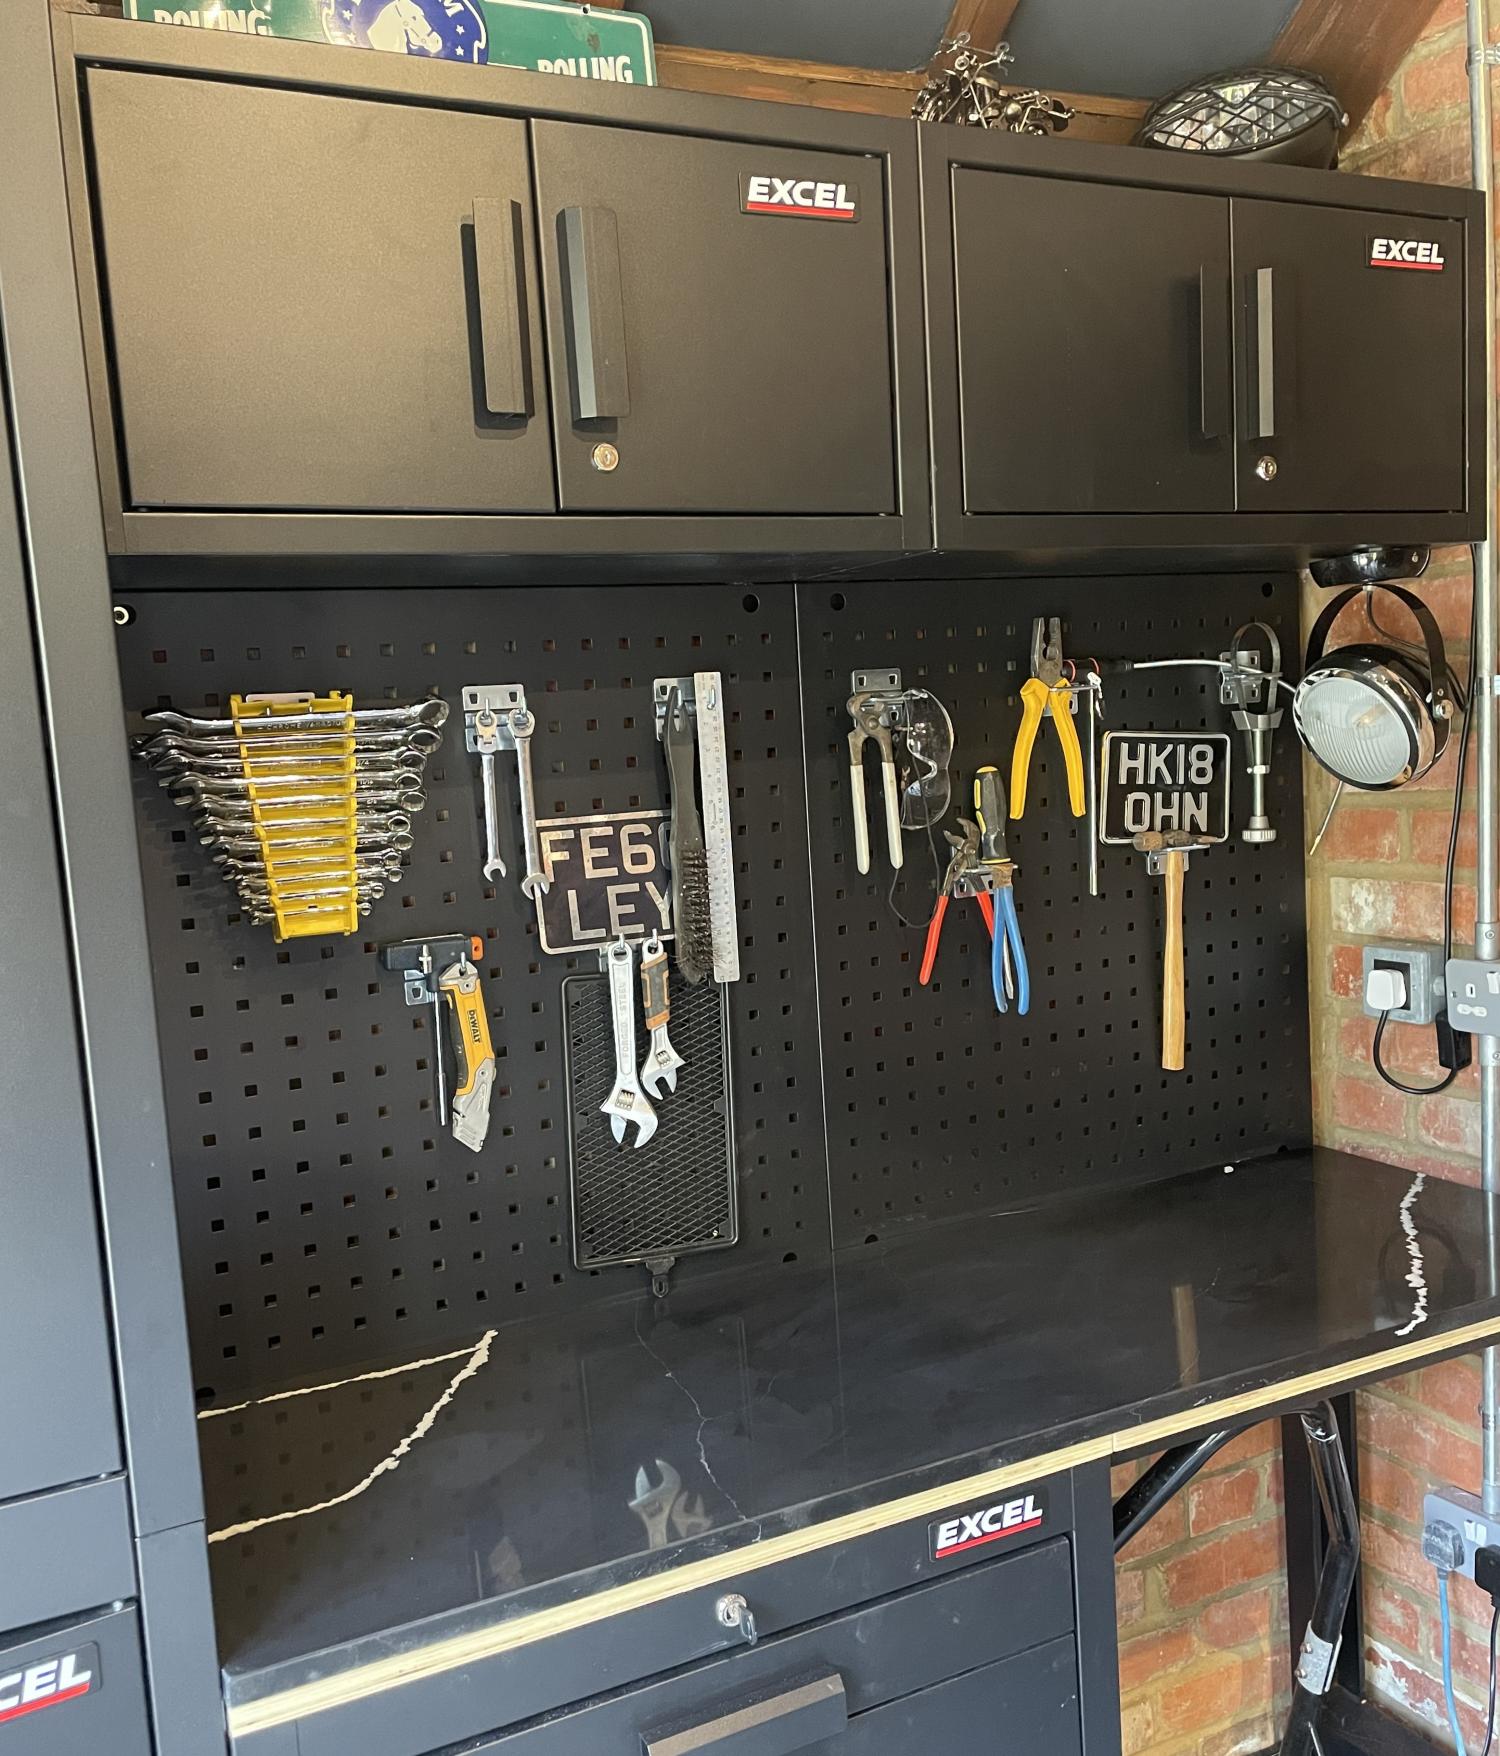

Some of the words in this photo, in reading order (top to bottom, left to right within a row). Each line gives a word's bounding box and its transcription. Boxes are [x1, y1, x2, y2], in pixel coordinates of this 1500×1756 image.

[747, 176, 855, 210] EXCEL
[1371, 238, 1445, 264] EXCEL
[1119, 742, 1214, 785] HK18
[1125, 791, 1208, 833] OHN
[567, 881, 674, 940] LEY
[937, 1495, 1043, 1550] EXCEL
